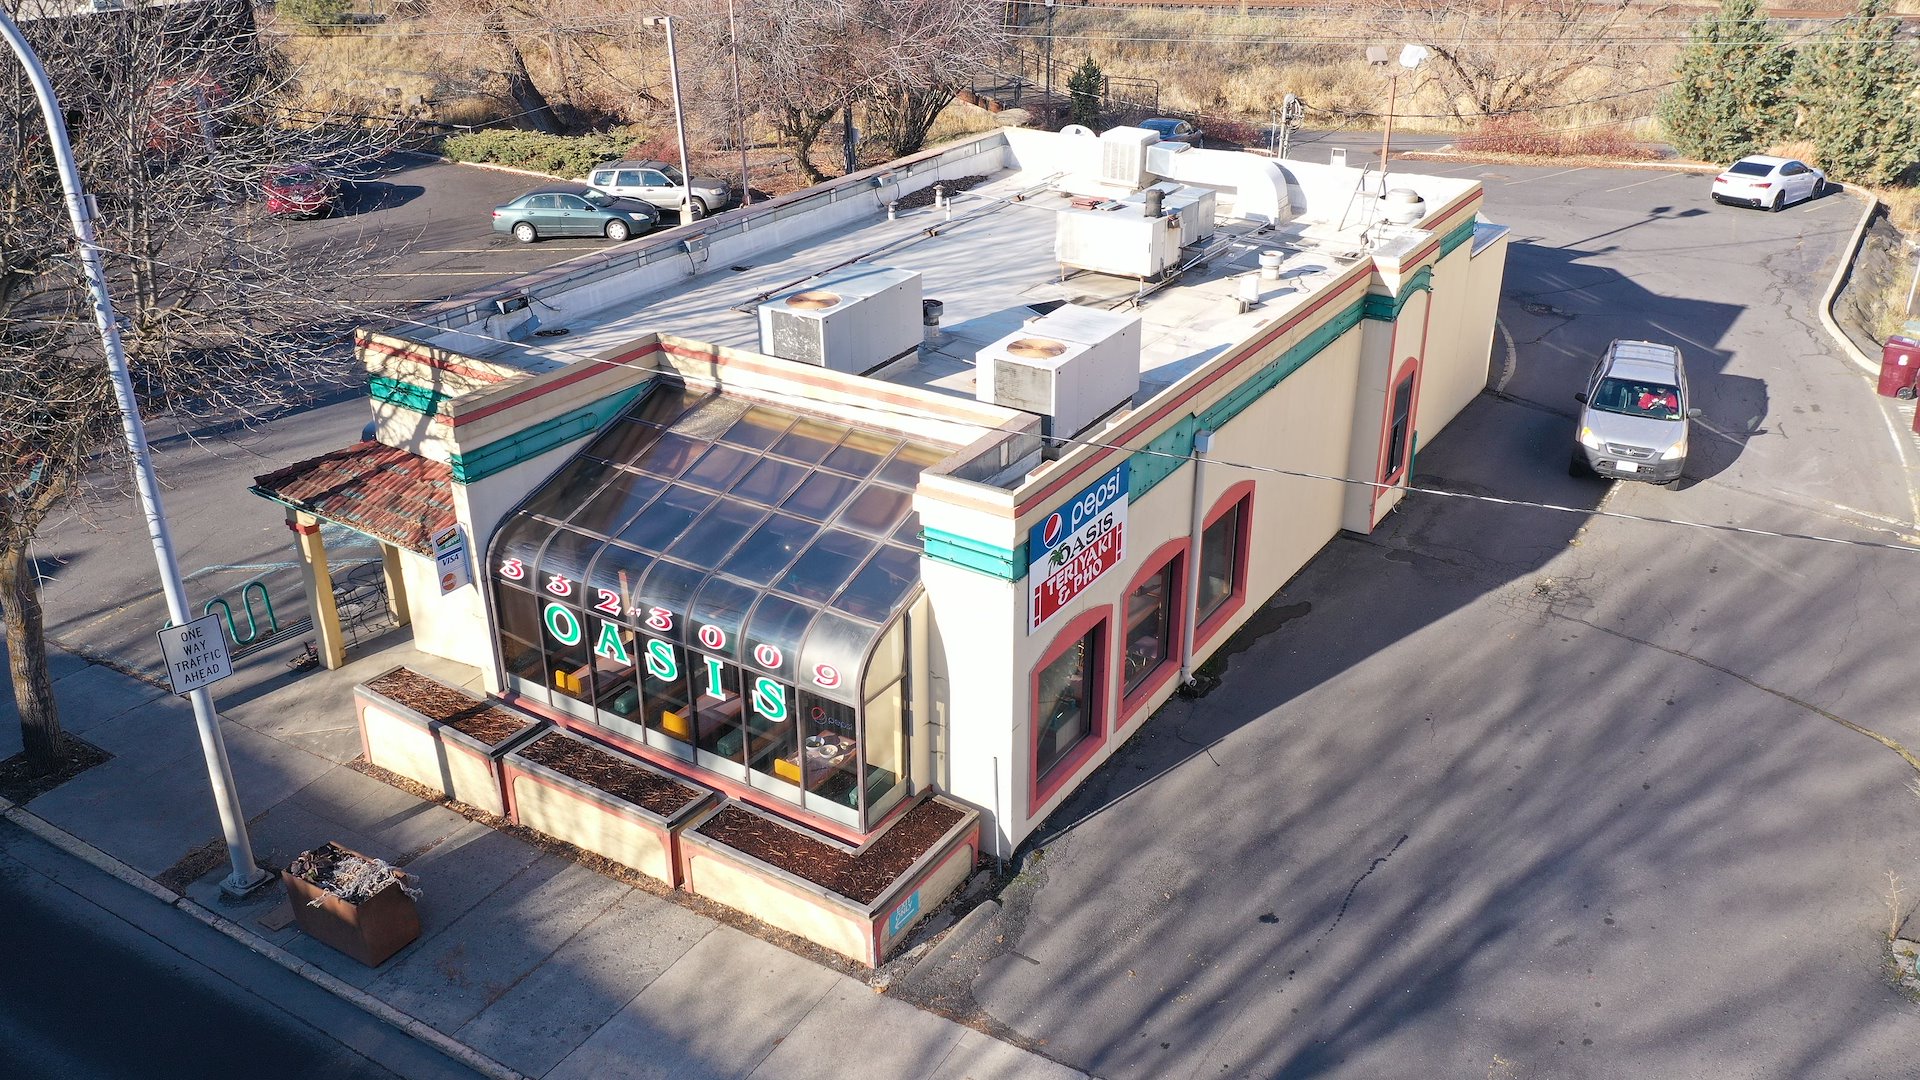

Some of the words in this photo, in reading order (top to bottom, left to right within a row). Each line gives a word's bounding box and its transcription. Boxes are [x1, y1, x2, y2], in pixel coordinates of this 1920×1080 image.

[1071, 467, 1120, 533] pepsi
[1057, 511, 1113, 567] OASIS
[442, 553, 460, 566] VISA
[1046, 531, 1113, 596] TERIYAKI
[1057, 585, 1071, 606] &
[1073, 558, 1103, 594] PHO
[180, 626, 203, 642] ONE
[183, 640, 206, 656] WAY
[174, 648, 221, 673] TRAFFIC
[185, 663, 220, 684] AHEAD
[544, 602, 787, 723] OASIS
